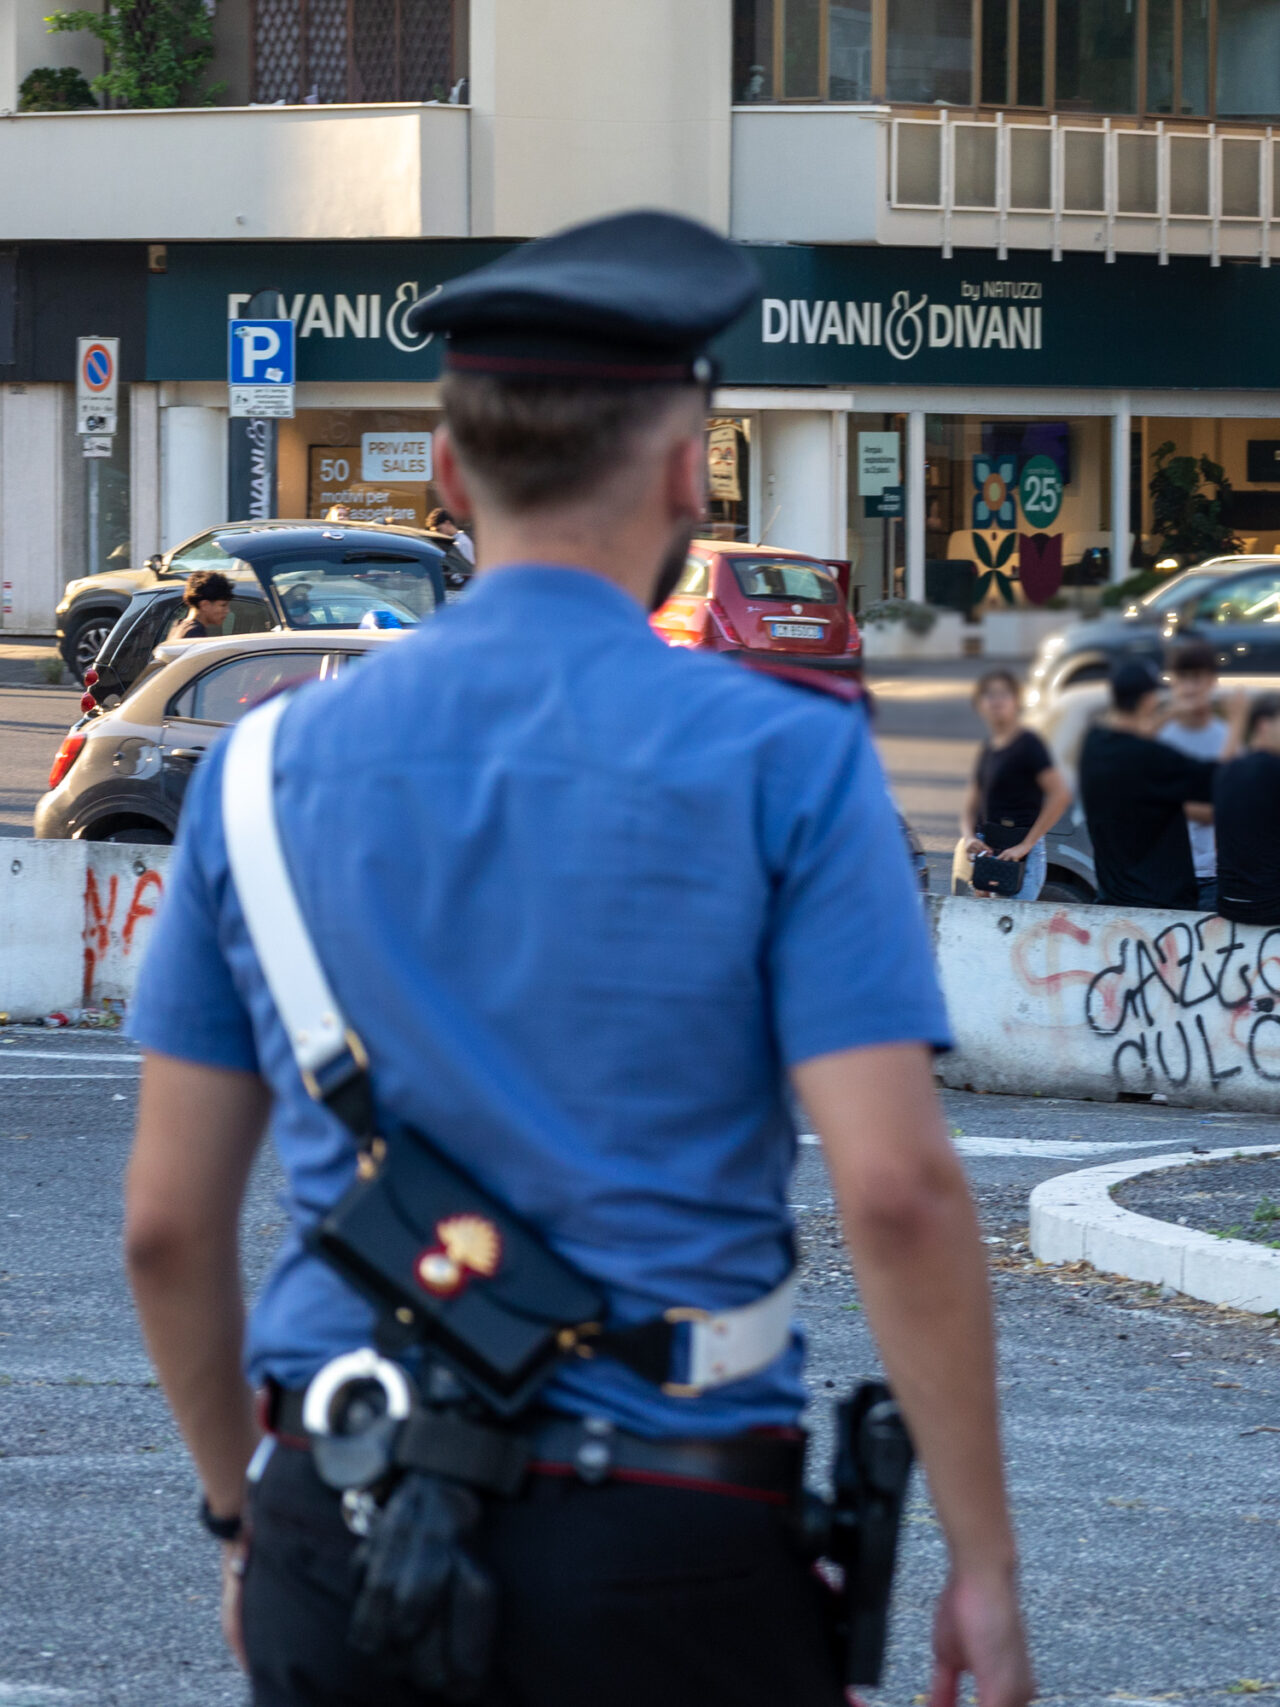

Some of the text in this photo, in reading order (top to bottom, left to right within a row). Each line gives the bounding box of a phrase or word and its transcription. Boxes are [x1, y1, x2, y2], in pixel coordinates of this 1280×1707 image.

[961, 281, 1042, 300] by NATUZZI
[242, 326, 280, 378] P
[368, 441, 426, 455] PRIVATE
[320, 459, 350, 482] 50
[382, 459, 426, 473] SALES
[321, 488, 390, 506] motivi per
[350, 505, 416, 520] aspettare
